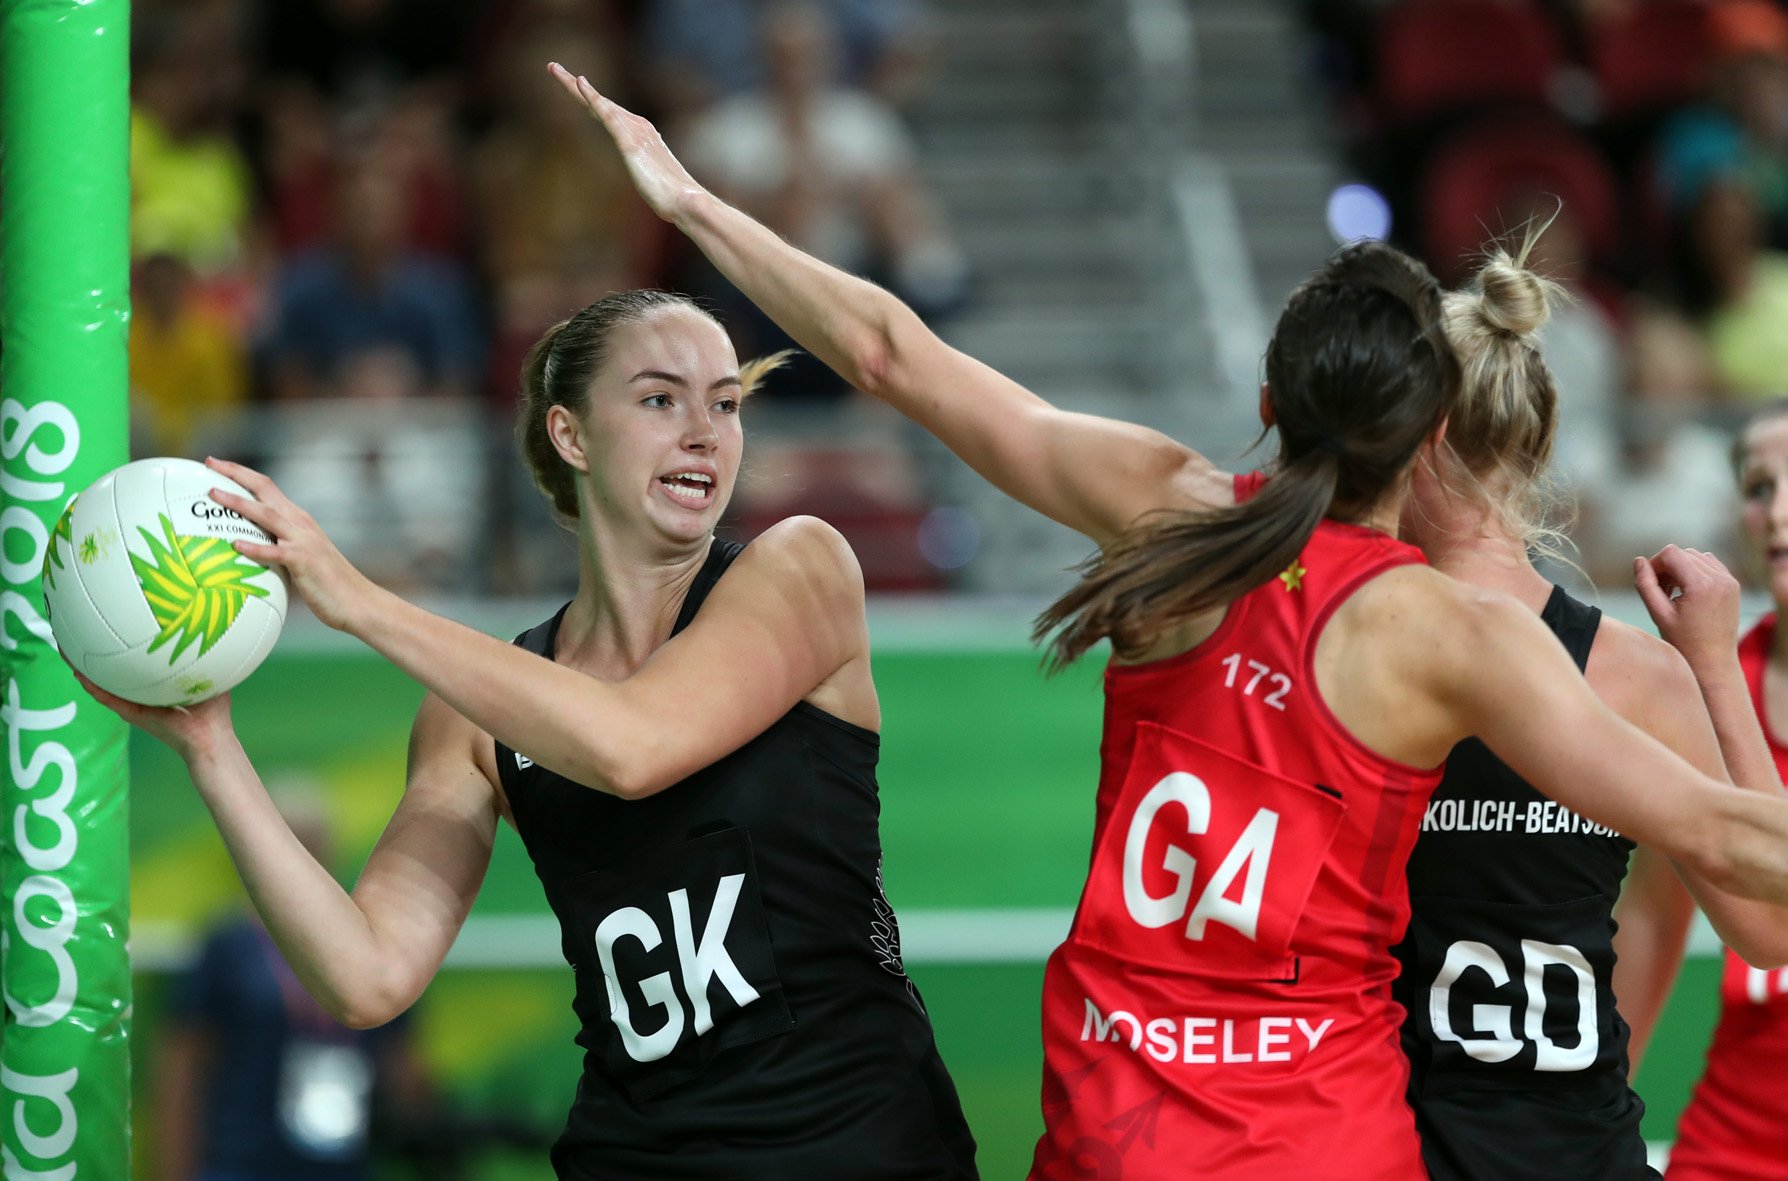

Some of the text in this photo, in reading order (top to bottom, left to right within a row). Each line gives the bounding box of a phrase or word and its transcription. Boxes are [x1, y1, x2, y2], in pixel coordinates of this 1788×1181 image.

[0, 397, 80, 653] 2018
[1222, 653, 1292, 711] 172
[1, 676, 78, 1028] Coast
[1122, 771, 1279, 943] GA
[595, 873, 761, 1063] GK
[1080, 998, 1335, 1063] MOSELEY
[1429, 938, 1599, 1072] GD
